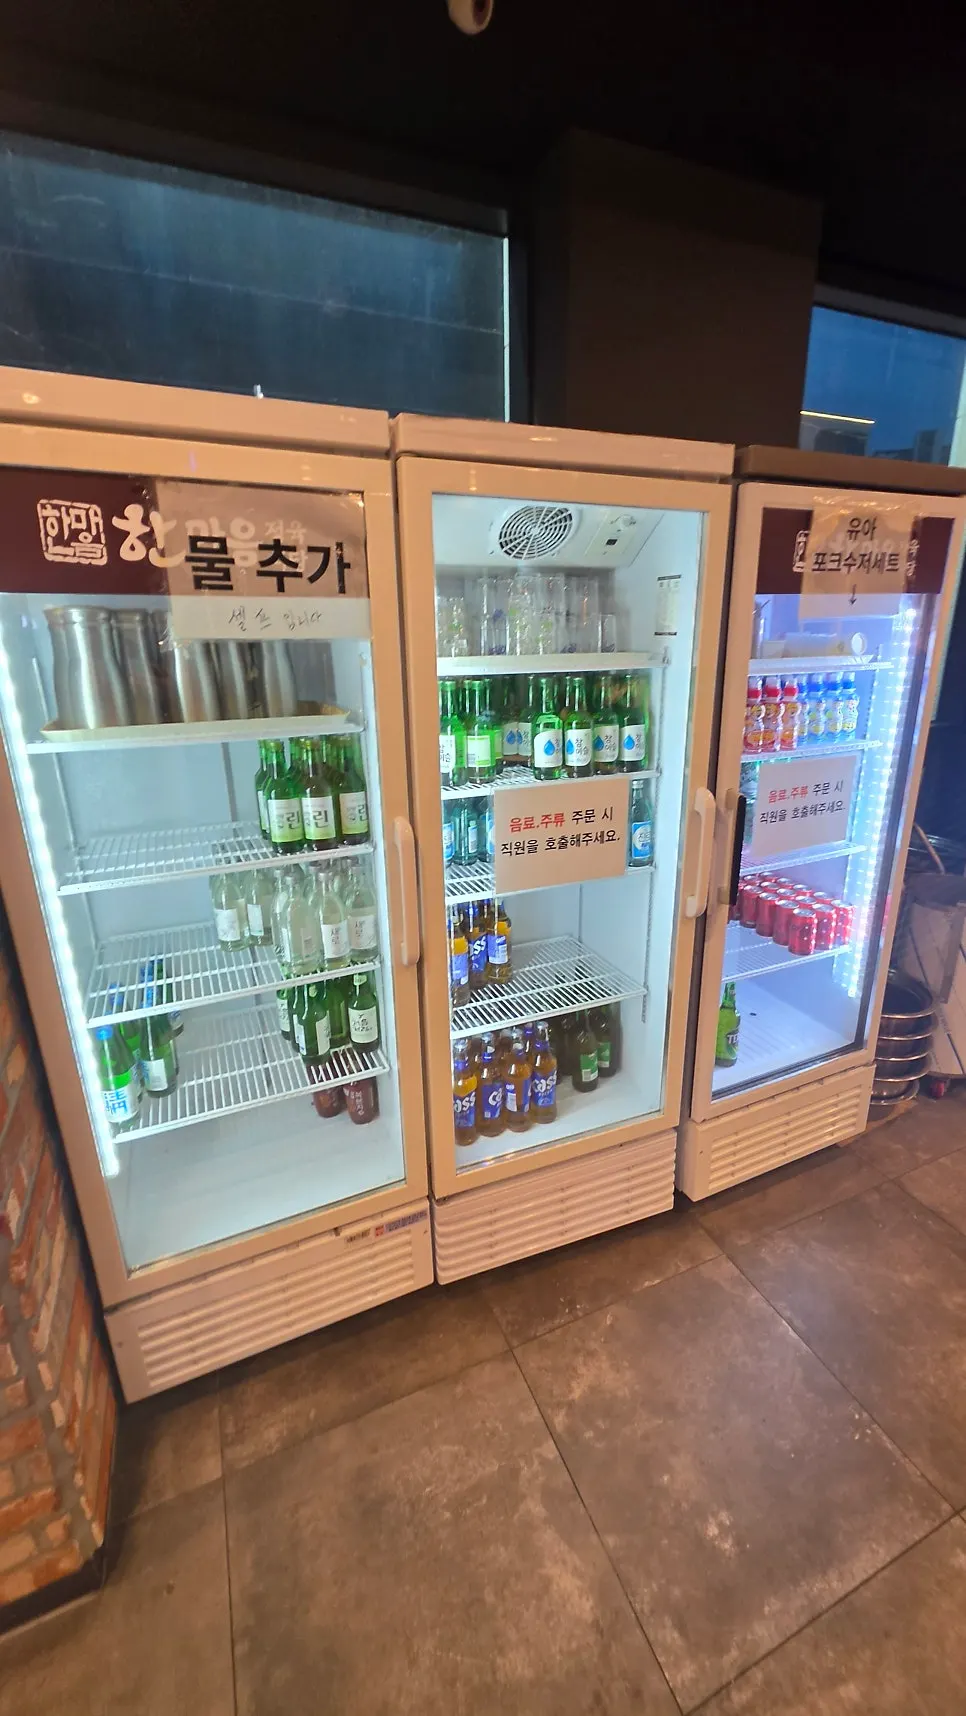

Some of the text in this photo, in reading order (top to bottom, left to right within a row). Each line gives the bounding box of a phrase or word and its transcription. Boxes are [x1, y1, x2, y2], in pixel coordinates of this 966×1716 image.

[847, 517, 877, 541] 유아
[812, 551, 900, 575] 포크수저세트
[812, 782, 831, 797] 주문
[312, 809, 329, 829] 린
[571, 808, 596, 824] 주문
[602, 806, 614, 821] 시
[759, 809, 787, 825] 직원을
[500, 829, 621, 857] 직원을 호출해주세요.
